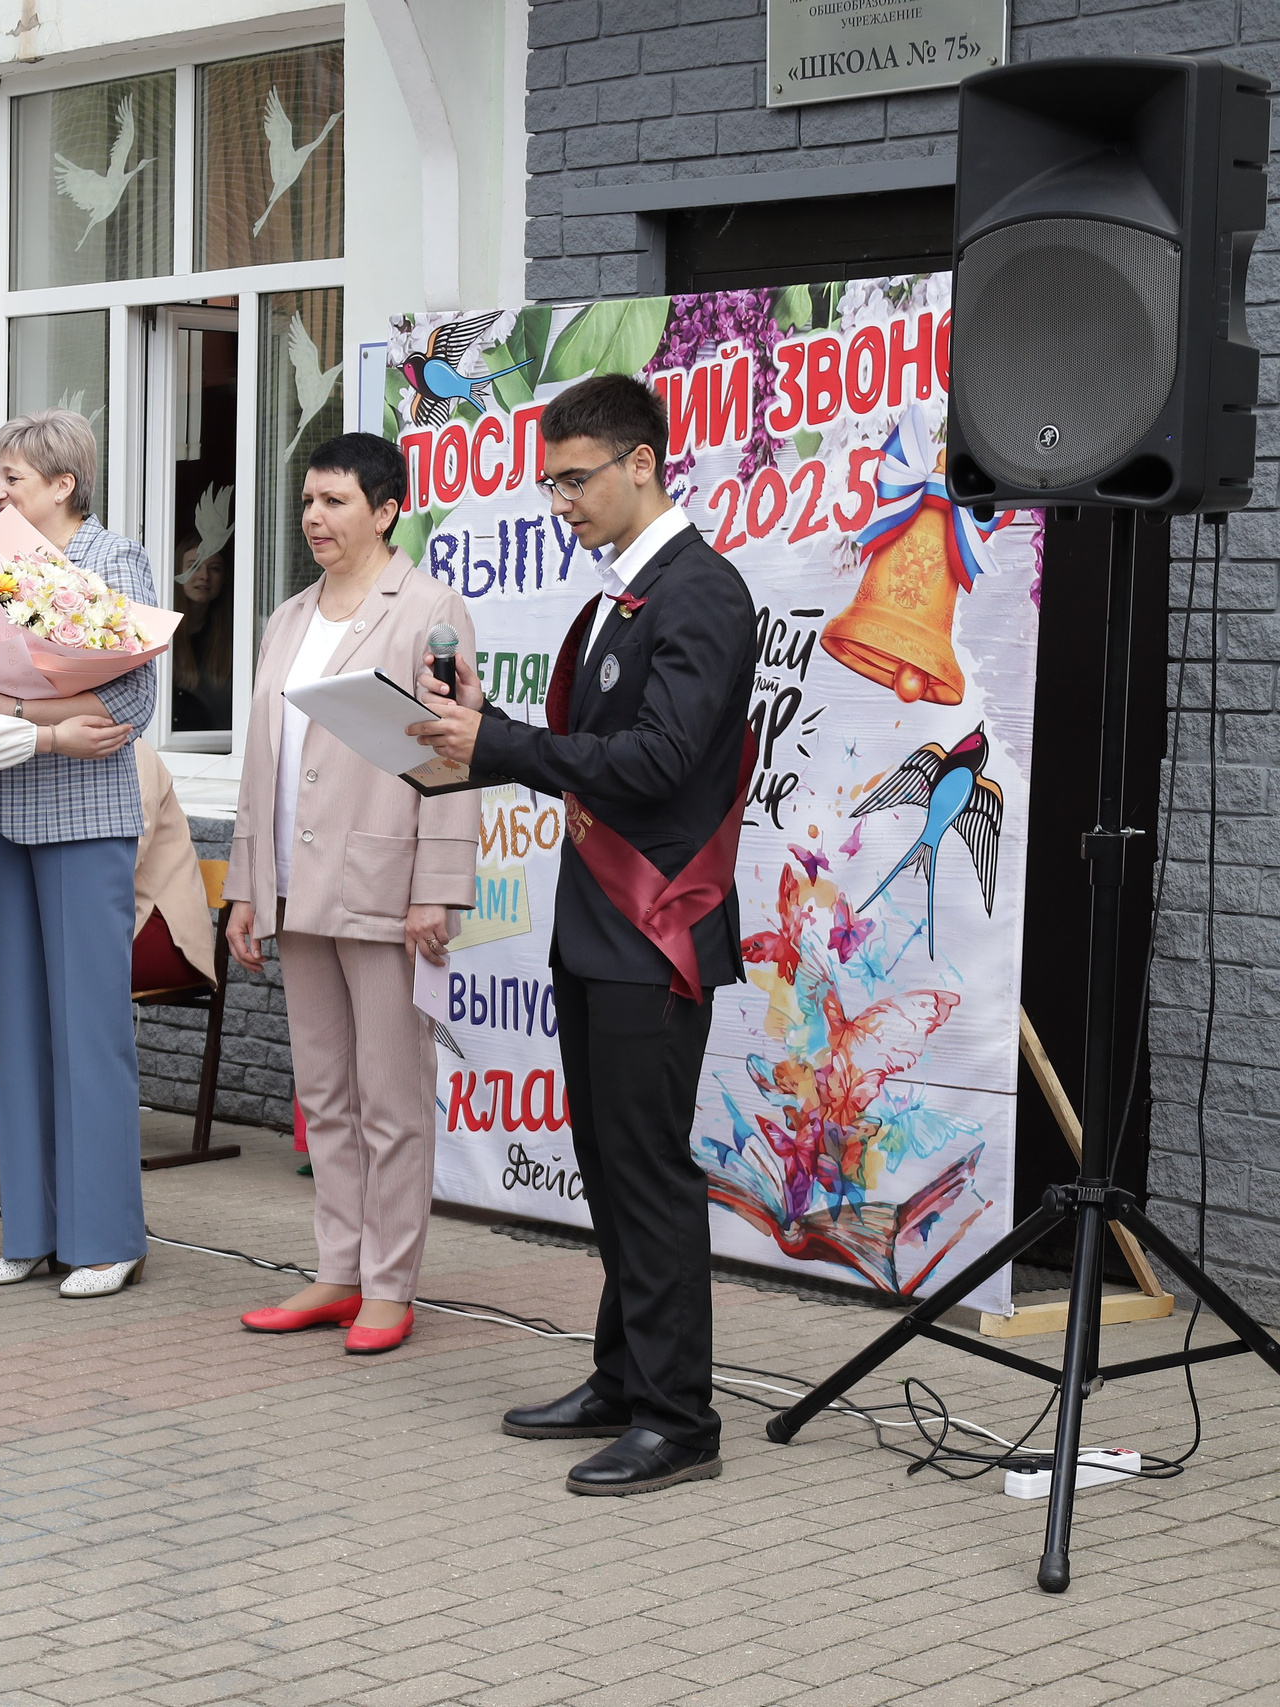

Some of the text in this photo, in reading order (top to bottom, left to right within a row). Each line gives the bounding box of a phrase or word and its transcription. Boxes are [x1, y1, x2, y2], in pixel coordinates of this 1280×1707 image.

[841, 7, 923, 29] УЧРЕЖДЕНИЕ
[787, 33, 982, 82] «ШКОЛА № 75»
[400, 346, 749, 512] ПОСЛИЙ
[708, 446, 886, 554] 2025
[502, 1142, 587, 1201] Дейс
